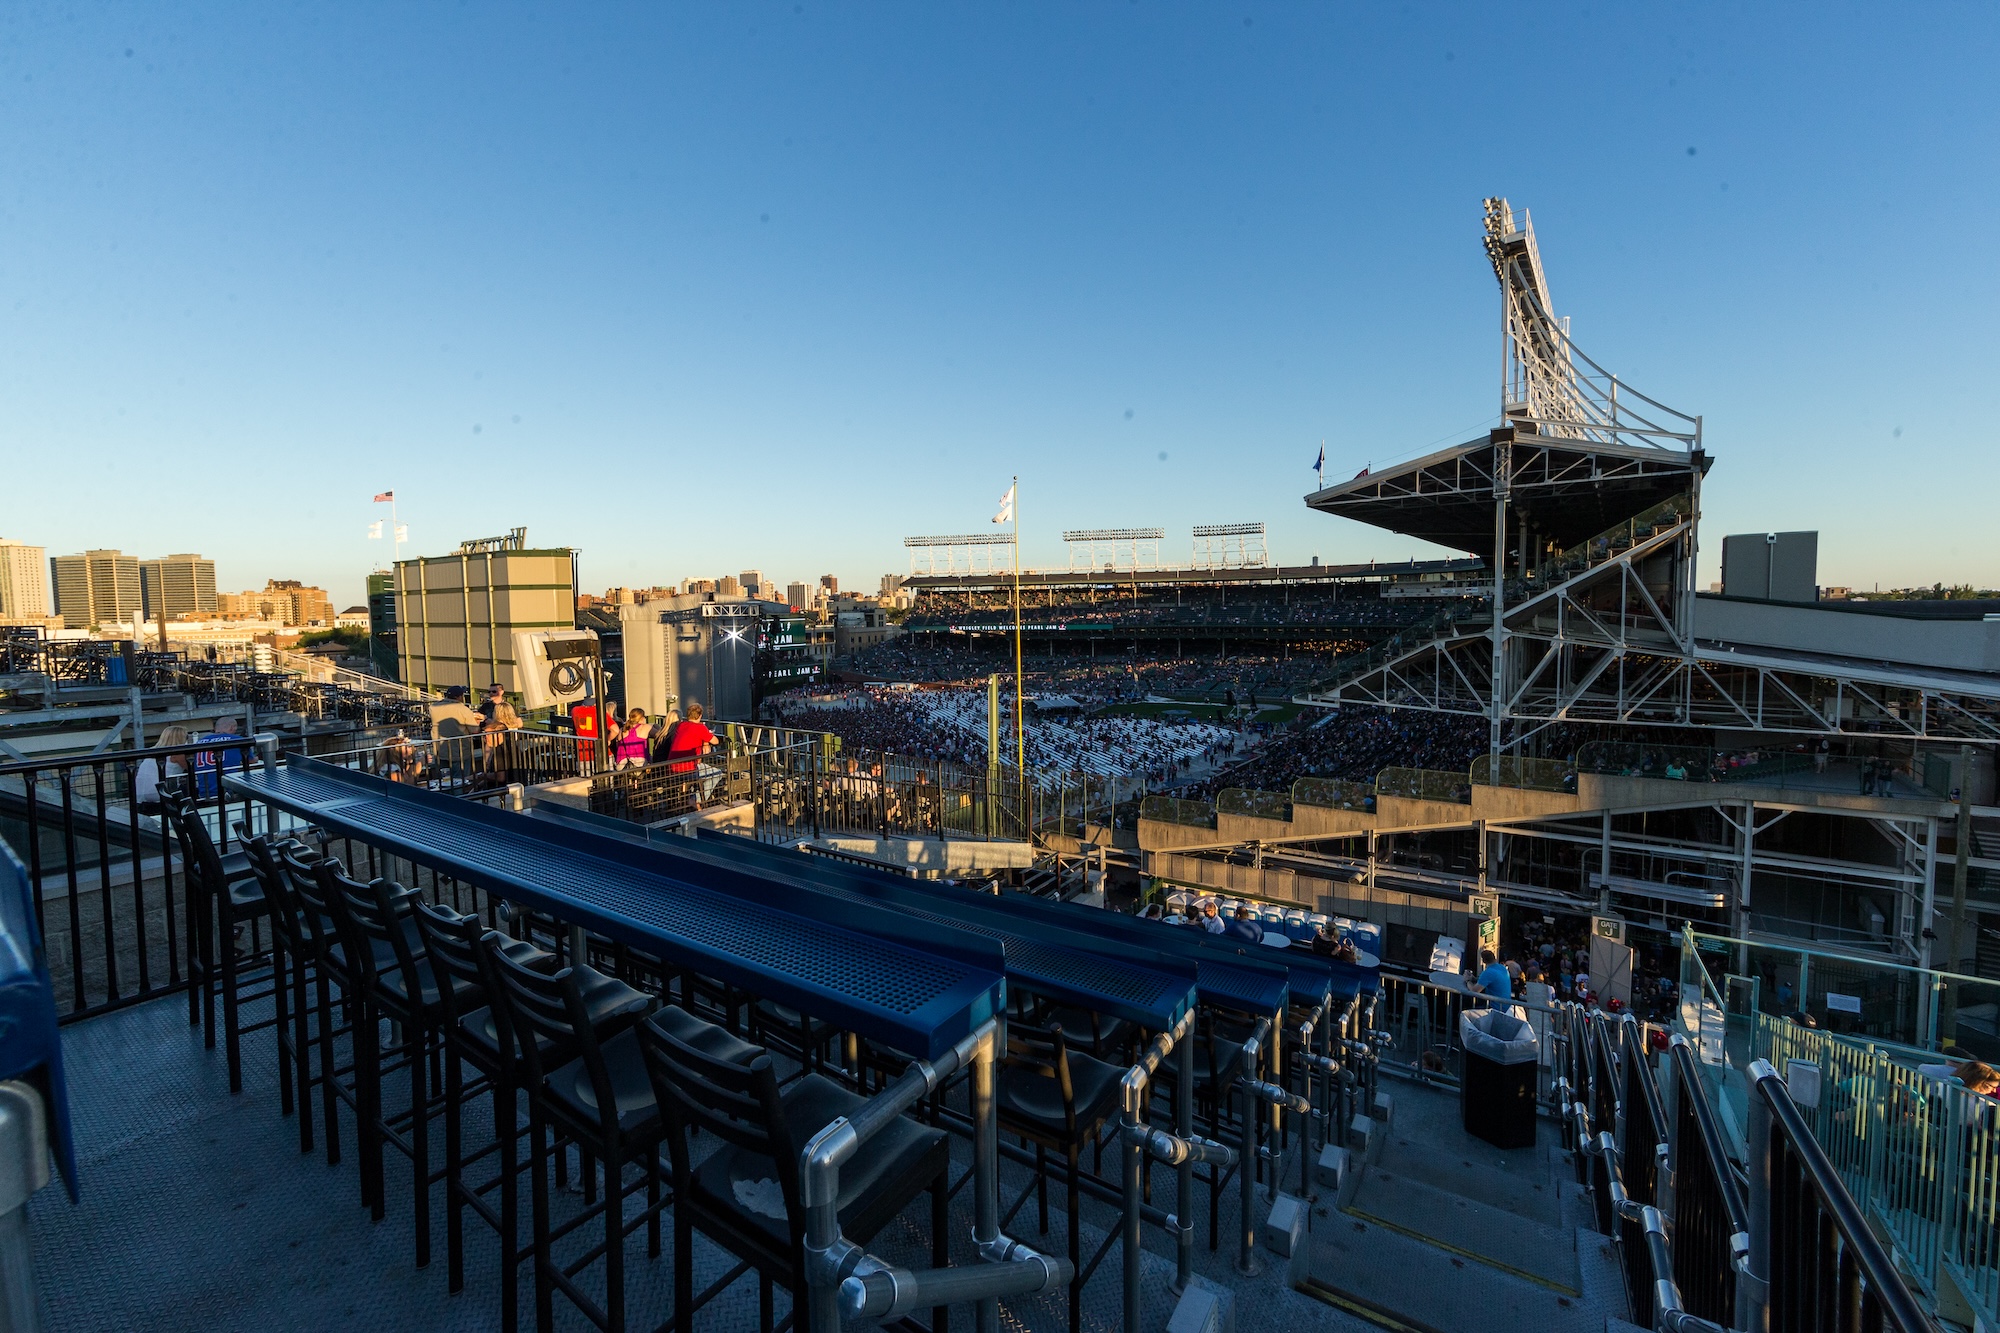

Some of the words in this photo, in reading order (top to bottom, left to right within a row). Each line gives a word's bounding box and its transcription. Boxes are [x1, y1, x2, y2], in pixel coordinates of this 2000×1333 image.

[774, 635, 792, 644] JAM
[797, 667, 810, 675] JAM
[1475, 900, 1491, 908] GATE
[1478, 906, 1487, 914] K
[1600, 921, 1617, 929] GATE
[1604, 928, 1613, 936] J
